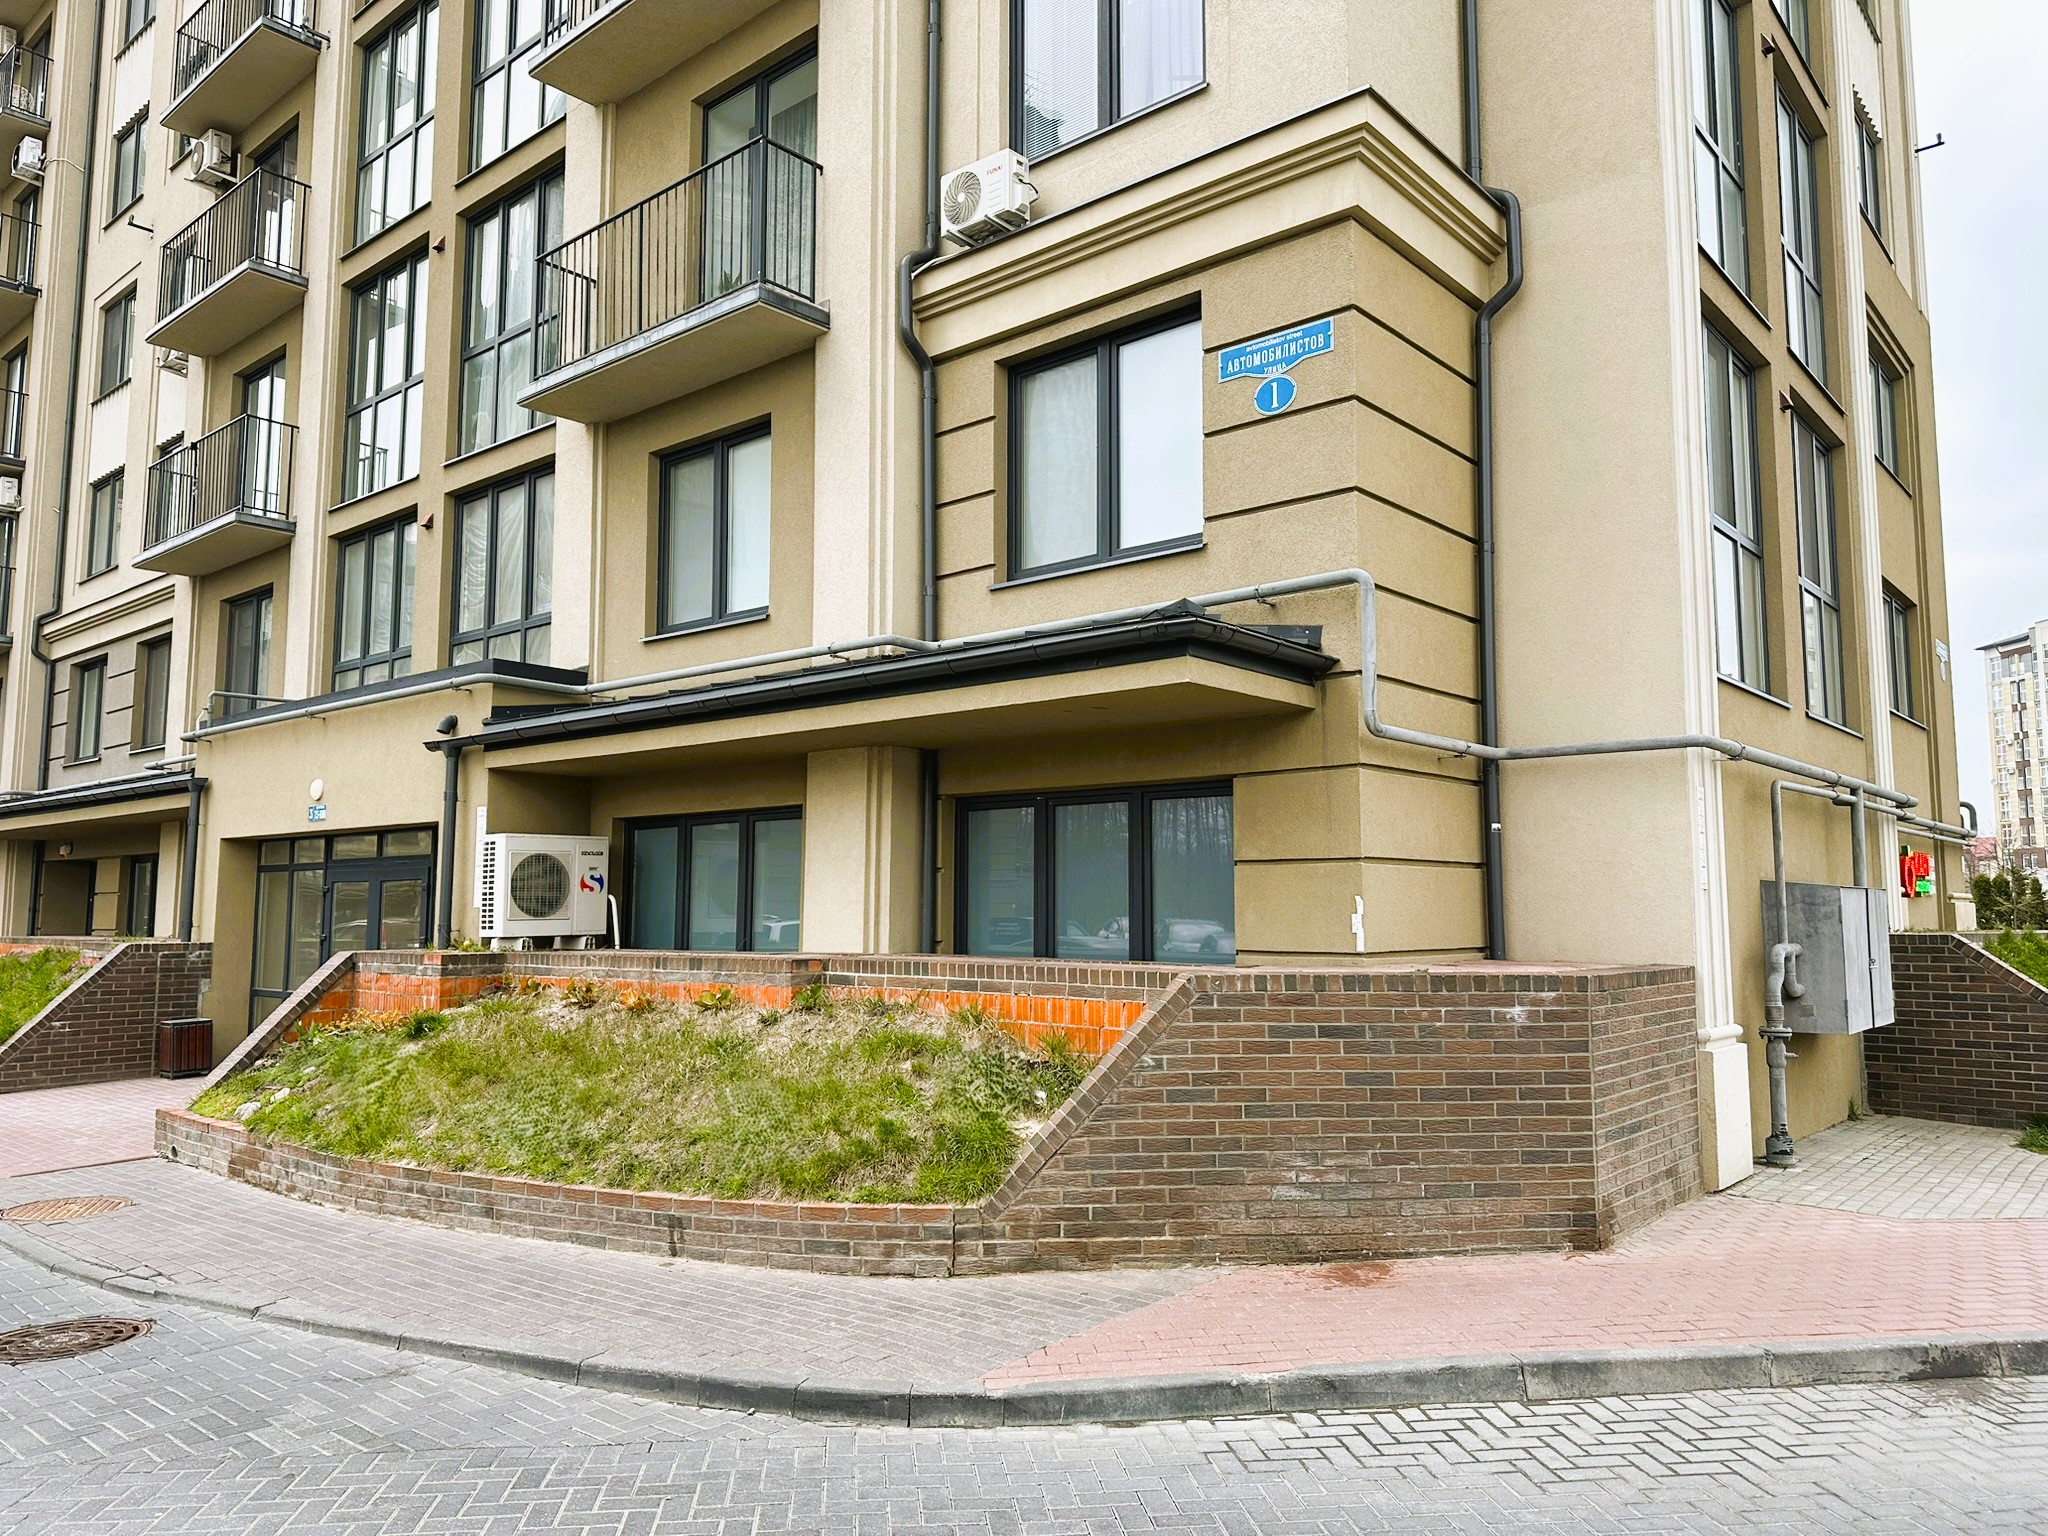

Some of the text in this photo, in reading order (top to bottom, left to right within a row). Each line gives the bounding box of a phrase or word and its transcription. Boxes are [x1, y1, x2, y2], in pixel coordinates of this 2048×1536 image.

[1286, 330, 1303, 340] street
[1227, 333, 1324, 374] АВТОМОБИЛИСТОВ
[1263, 361, 1287, 375] УЛИЦА
[1270, 381, 1279, 408] 1
